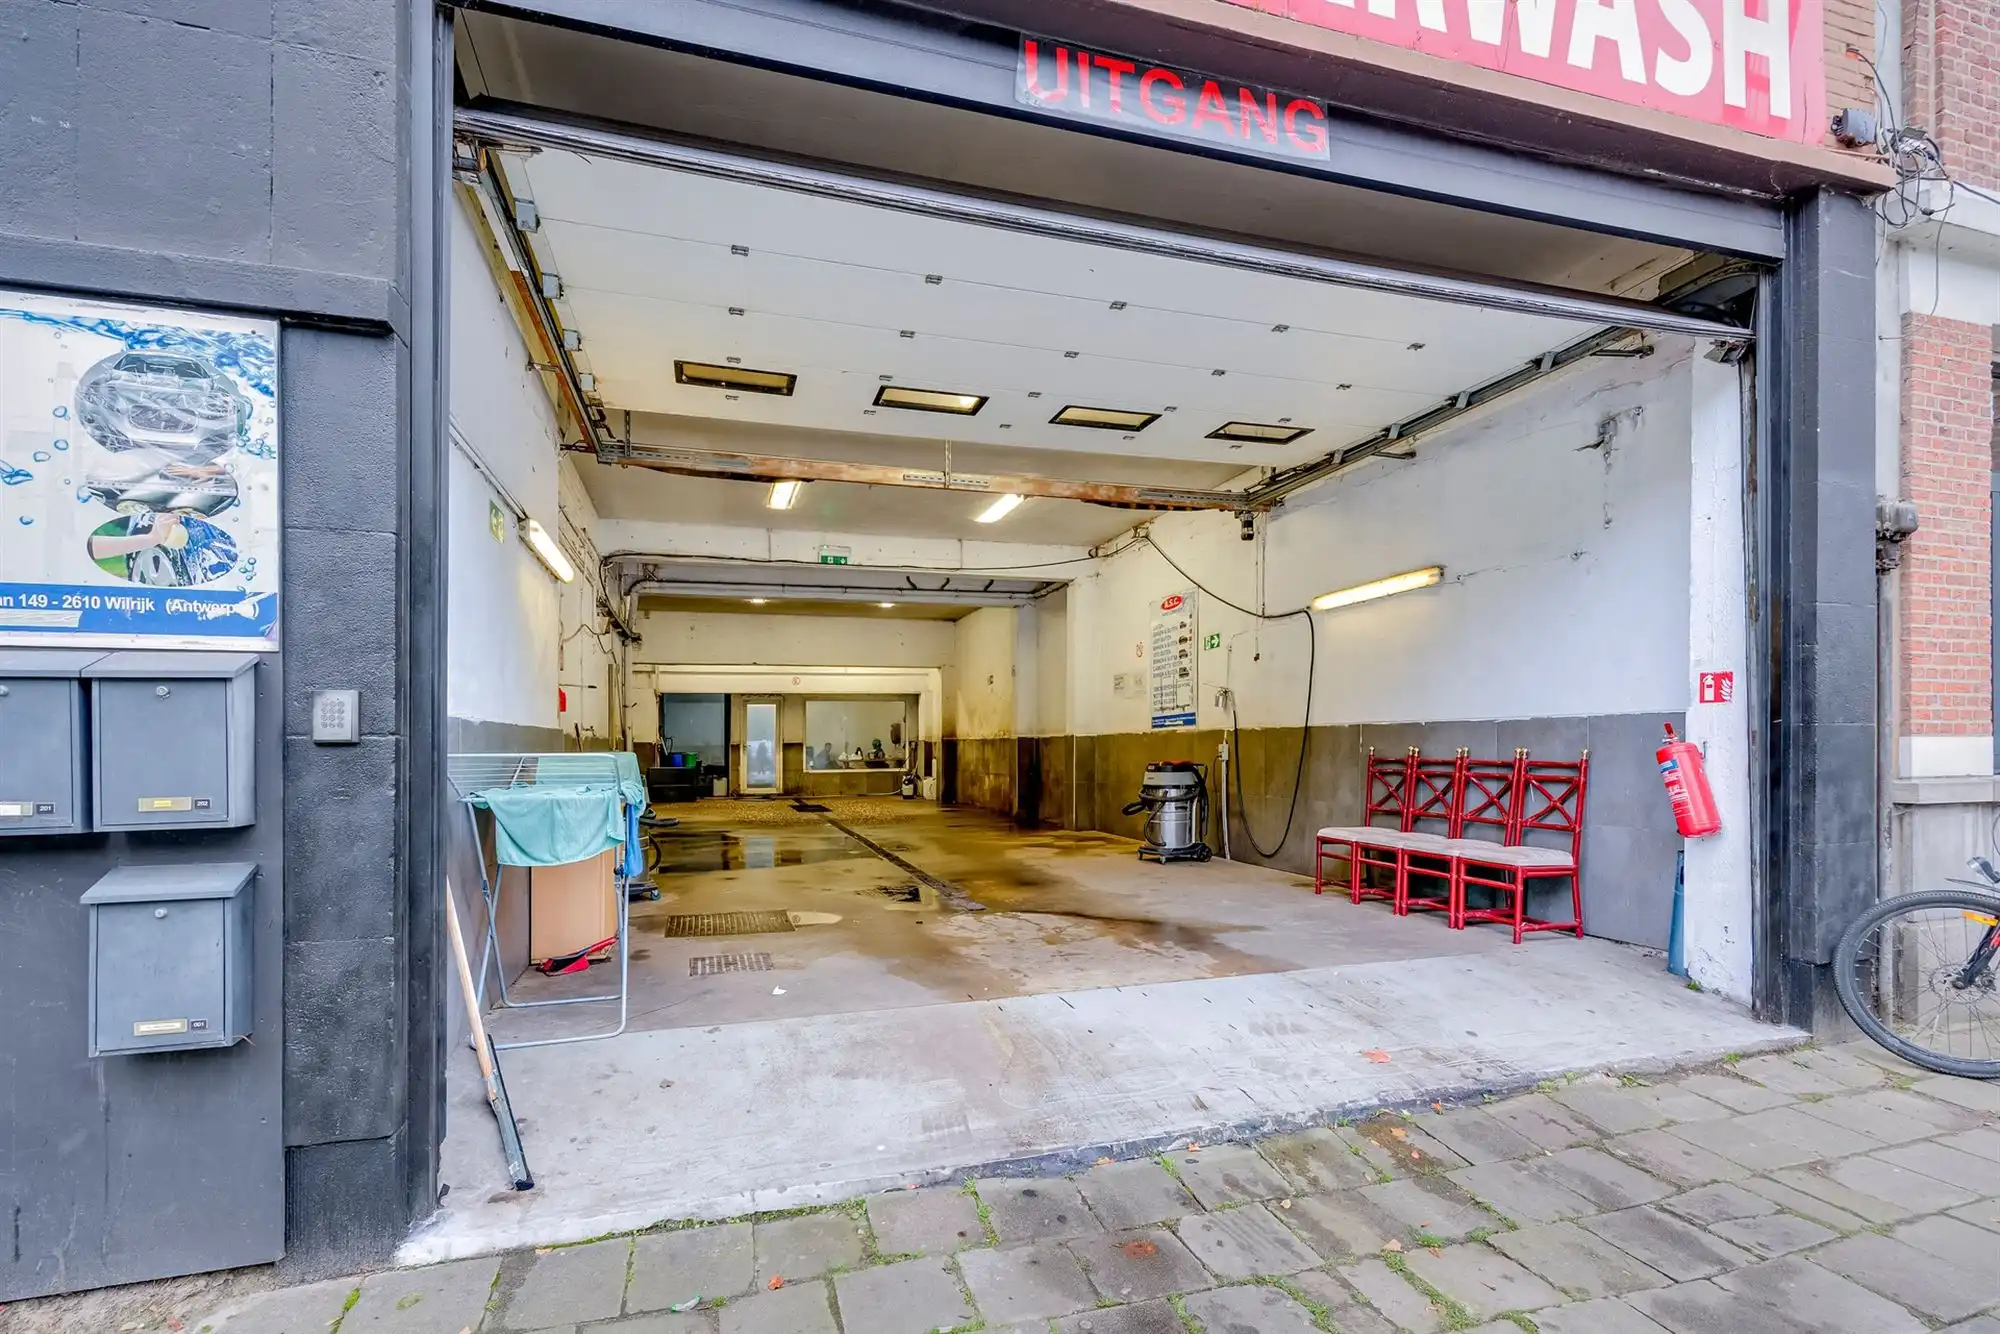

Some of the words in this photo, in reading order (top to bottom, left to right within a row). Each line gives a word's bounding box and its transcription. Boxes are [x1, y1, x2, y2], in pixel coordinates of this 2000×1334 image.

[1023, 39, 1327, 154] UITGANG
[18, 593, 48, 608] 149
[62, 595, 101, 609] 2610
[104, 596, 156, 614] Wilrijk
